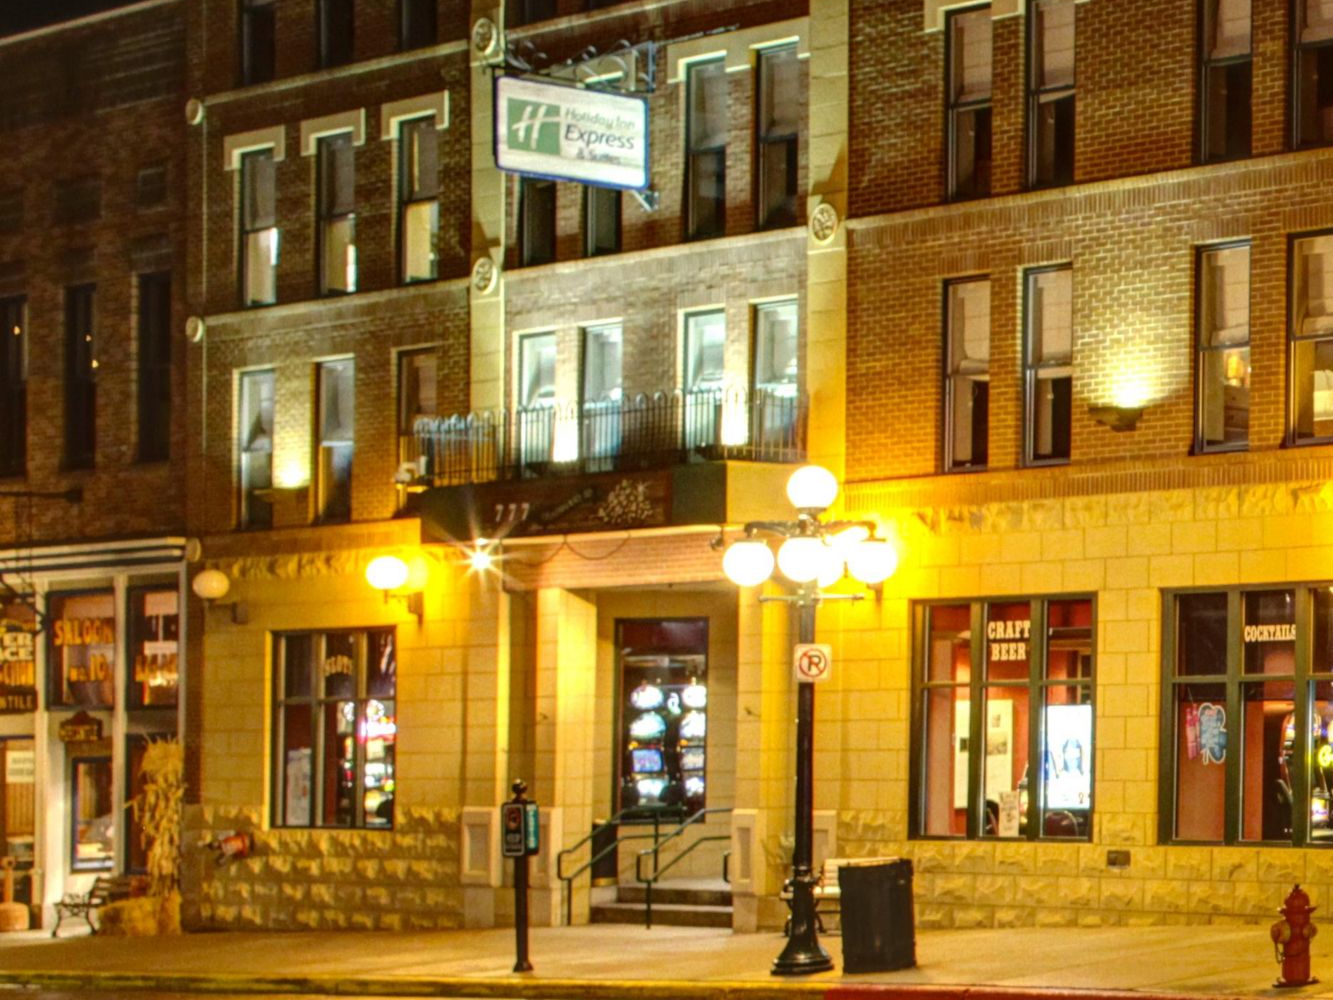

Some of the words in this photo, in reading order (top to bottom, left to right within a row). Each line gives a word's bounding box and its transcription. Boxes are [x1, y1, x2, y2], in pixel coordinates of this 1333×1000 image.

[565, 107, 613, 130] Holiday
[615, 114, 635, 129] Inn
[565, 124, 635, 150] Express
[576, 147, 587, 161] &
[588, 149, 621, 165] Suites
[54, 618, 114, 646] SALOON
[988, 620, 1031, 639] CRAFT
[1244, 624, 1296, 642] COCKTAILS
[991, 642, 1026, 661] BEER
